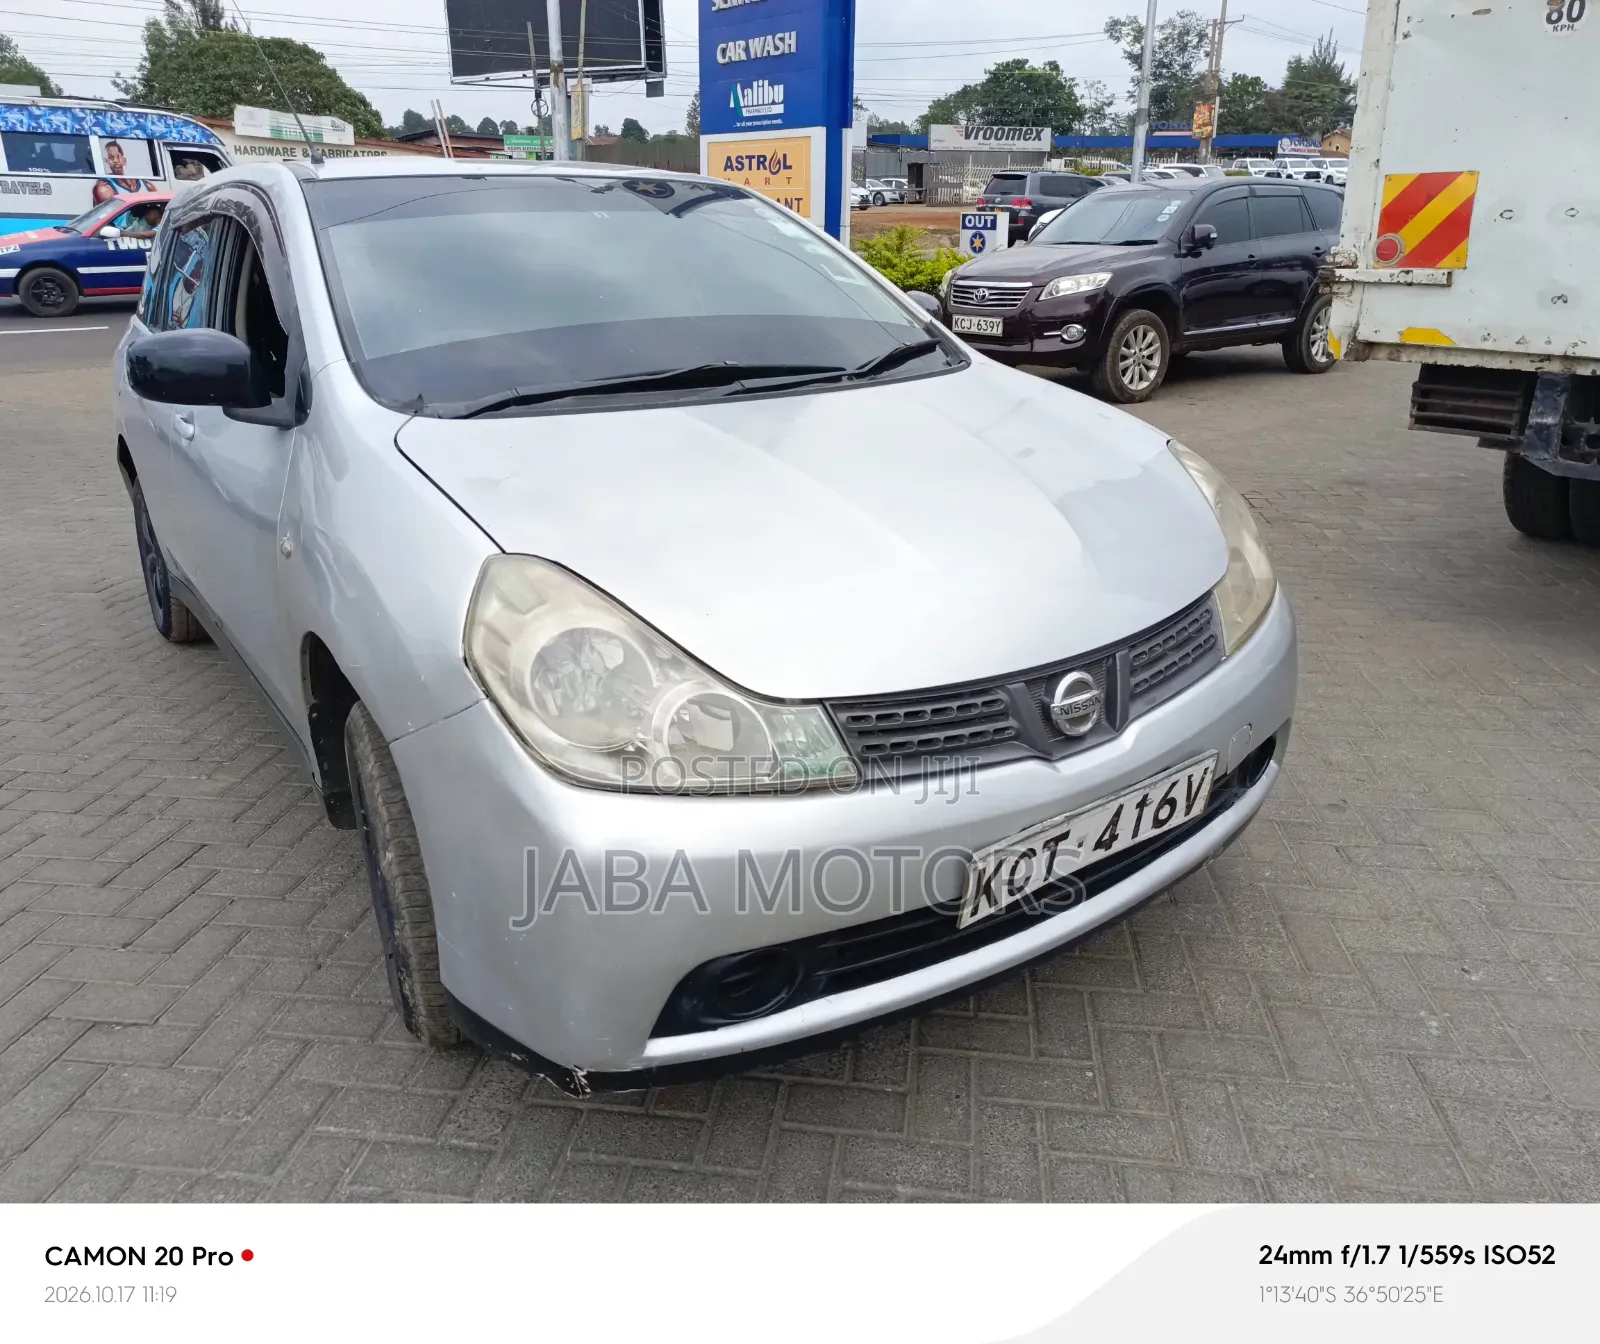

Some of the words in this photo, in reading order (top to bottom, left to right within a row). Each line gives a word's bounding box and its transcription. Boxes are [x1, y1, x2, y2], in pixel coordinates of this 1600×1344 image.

[1552, 23, 1575, 33] KPH
[716, 40, 747, 64] CAR
[748, 31, 797, 59] WASH
[729, 79, 785, 110] Malibu
[745, 107, 764, 115] PHARMACY
[963, 125, 1045, 142] vroomex
[234, 144, 297, 158] HARDWARE
[301, 147, 311, 158] &
[317, 148, 388, 158] ABRICATORS
[964, 214, 995, 228] OUT
[1060, 696, 1101, 717] NISSAN
